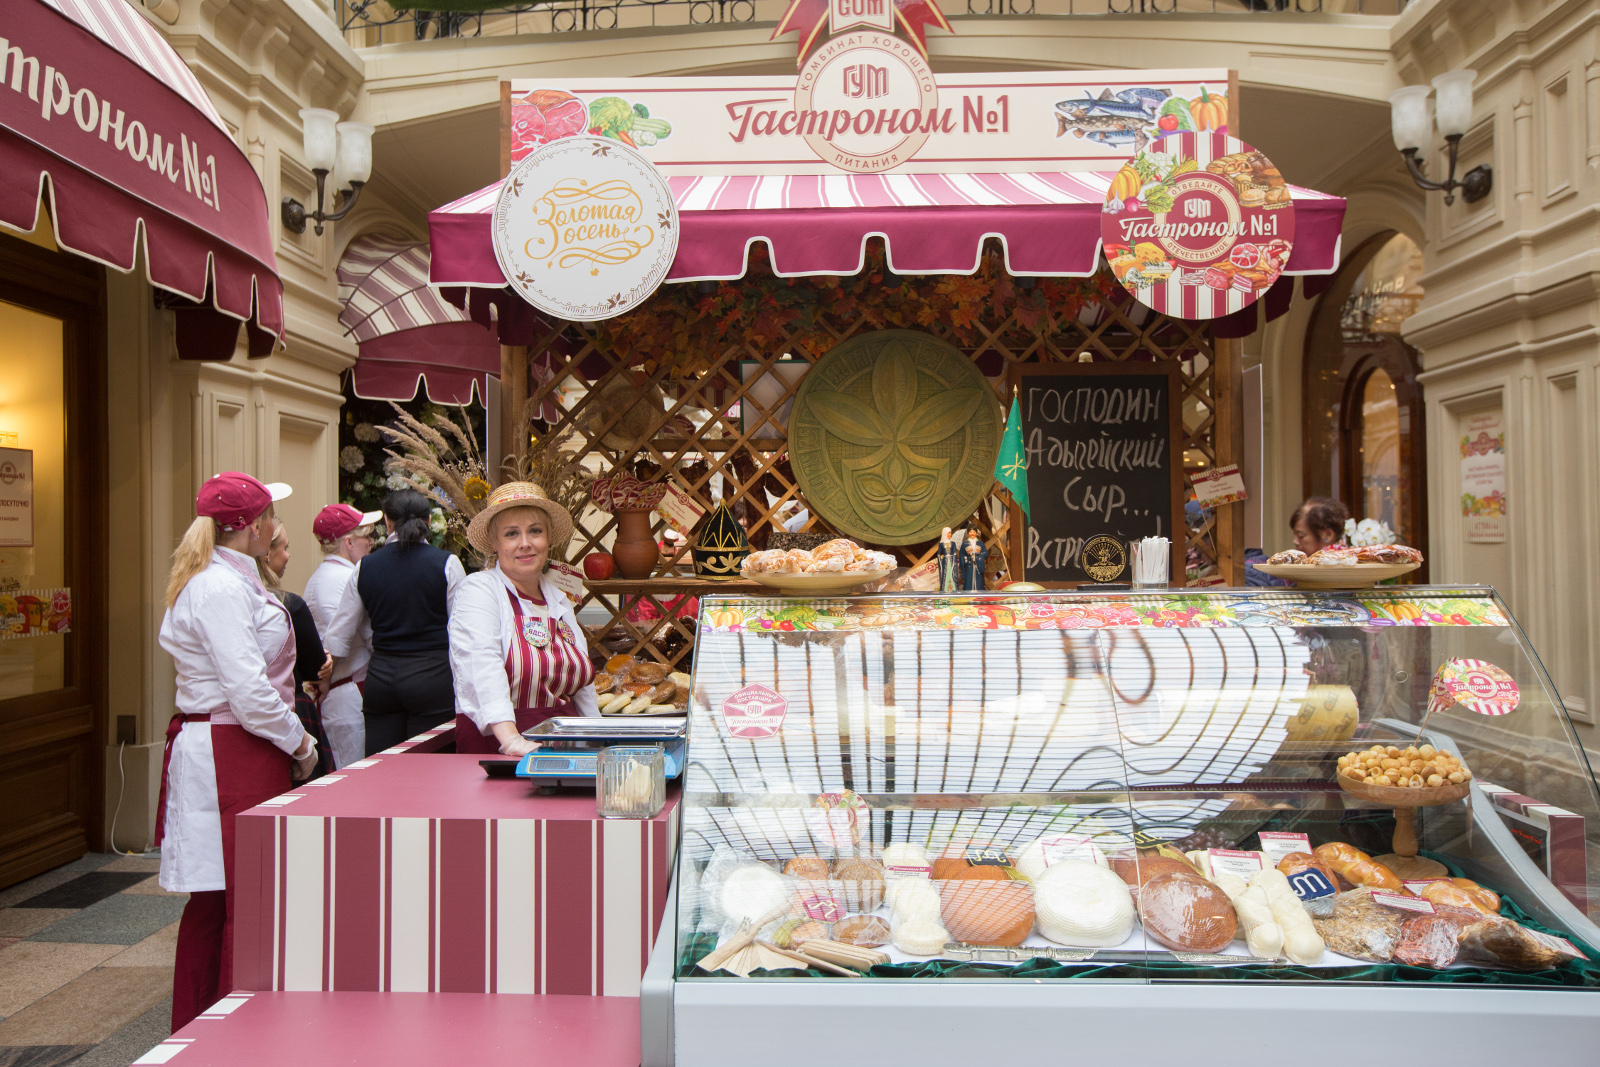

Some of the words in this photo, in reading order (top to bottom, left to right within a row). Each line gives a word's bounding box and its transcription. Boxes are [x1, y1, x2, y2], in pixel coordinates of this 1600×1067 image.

[800, 35, 863, 92] КОМБИНАТ
[871, 35, 932, 93] ХОРОШЕГО
[842, 63, 889, 100] ГУМ
[725, 98, 957, 143] Гастроном
[962, 94, 1009, 134] №1
[180, 132, 220, 212] №1
[834, 153, 899, 169] ПИТАНИЯ
[1171, 181, 1224, 195] ОТВЕДАЙТЕ
[1183, 198, 1212, 219] ГУМ
[563, 223, 630, 244] осень
[1118, 216, 1248, 241] Гастроном
[1250, 214, 1278, 236] №1
[1166, 240, 1230, 260] ОТЕЧЕСТВЕННОЕ
[1027, 387, 1161, 425] ГОСПОДИН
